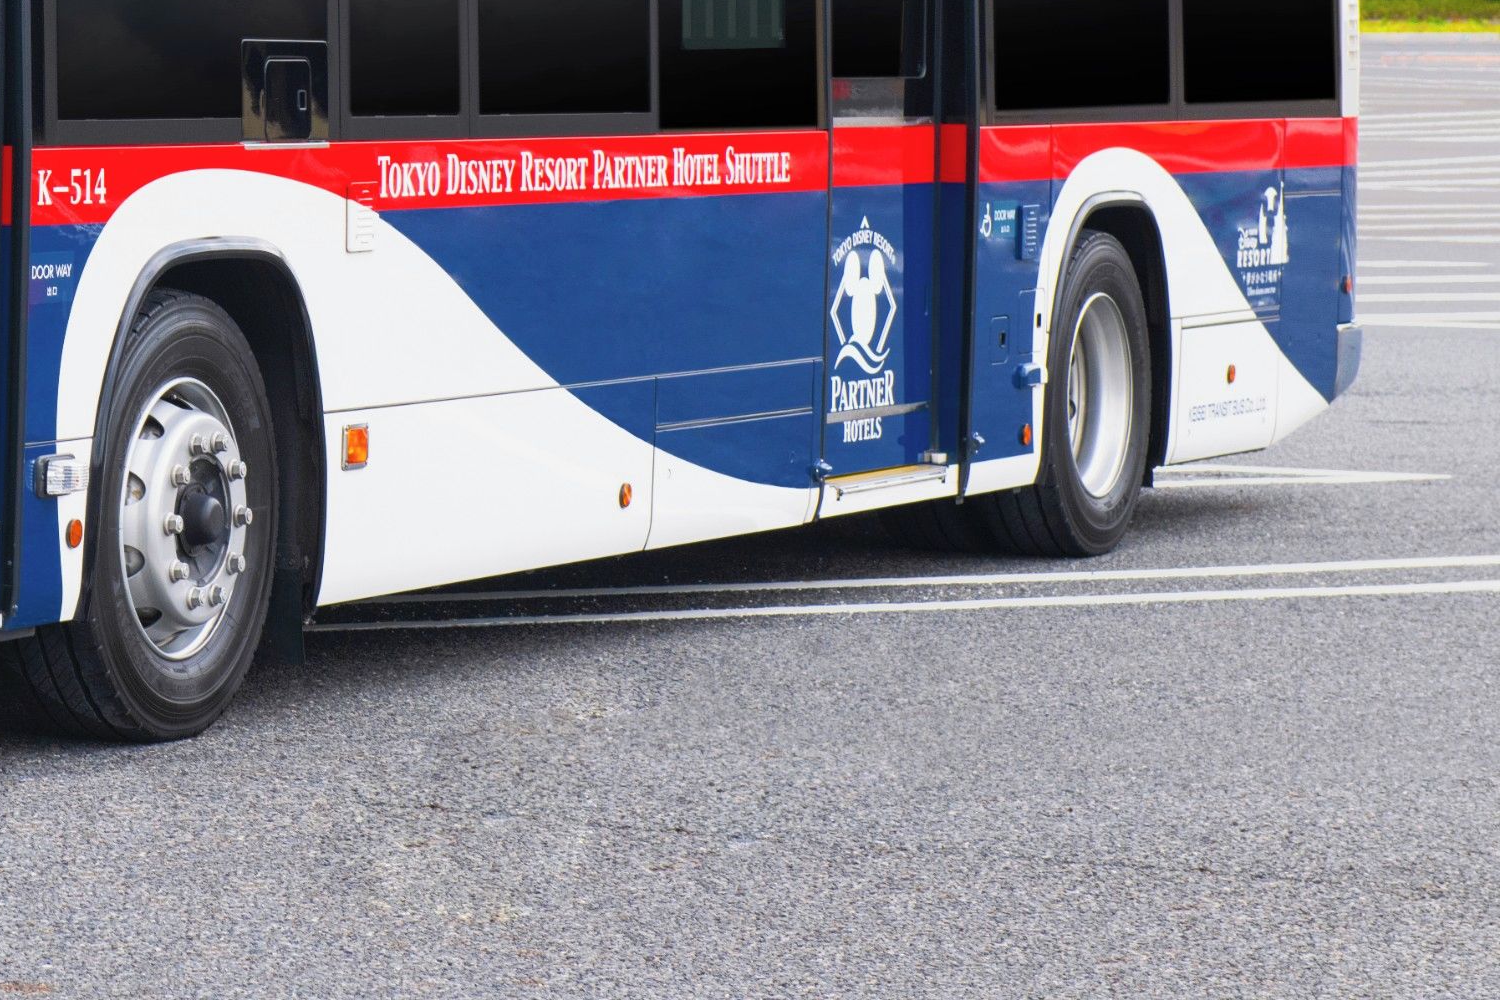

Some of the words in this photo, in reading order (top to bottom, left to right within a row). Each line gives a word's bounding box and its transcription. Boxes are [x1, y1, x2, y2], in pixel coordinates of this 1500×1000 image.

[37, 167, 107, 206] K-514
[377, 155, 441, 199] TOKYO
[446, 153, 516, 195] DISNEY
[520, 151, 588, 192] RESORT
[593, 149, 669, 190] PARTNER
[673, 147, 721, 187] HOTEL
[725, 145, 791, 185] SHUTTLE
[832, 236, 852, 266] TOKYO
[852, 229, 874, 248] DISNEY
[1237, 249, 1271, 268] RESORT
[31, 264, 54, 280] DOOR
[55, 263, 72, 278] WAY
[830, 369, 895, 413] PARTNER
[843, 416, 882, 443] HOTELS
